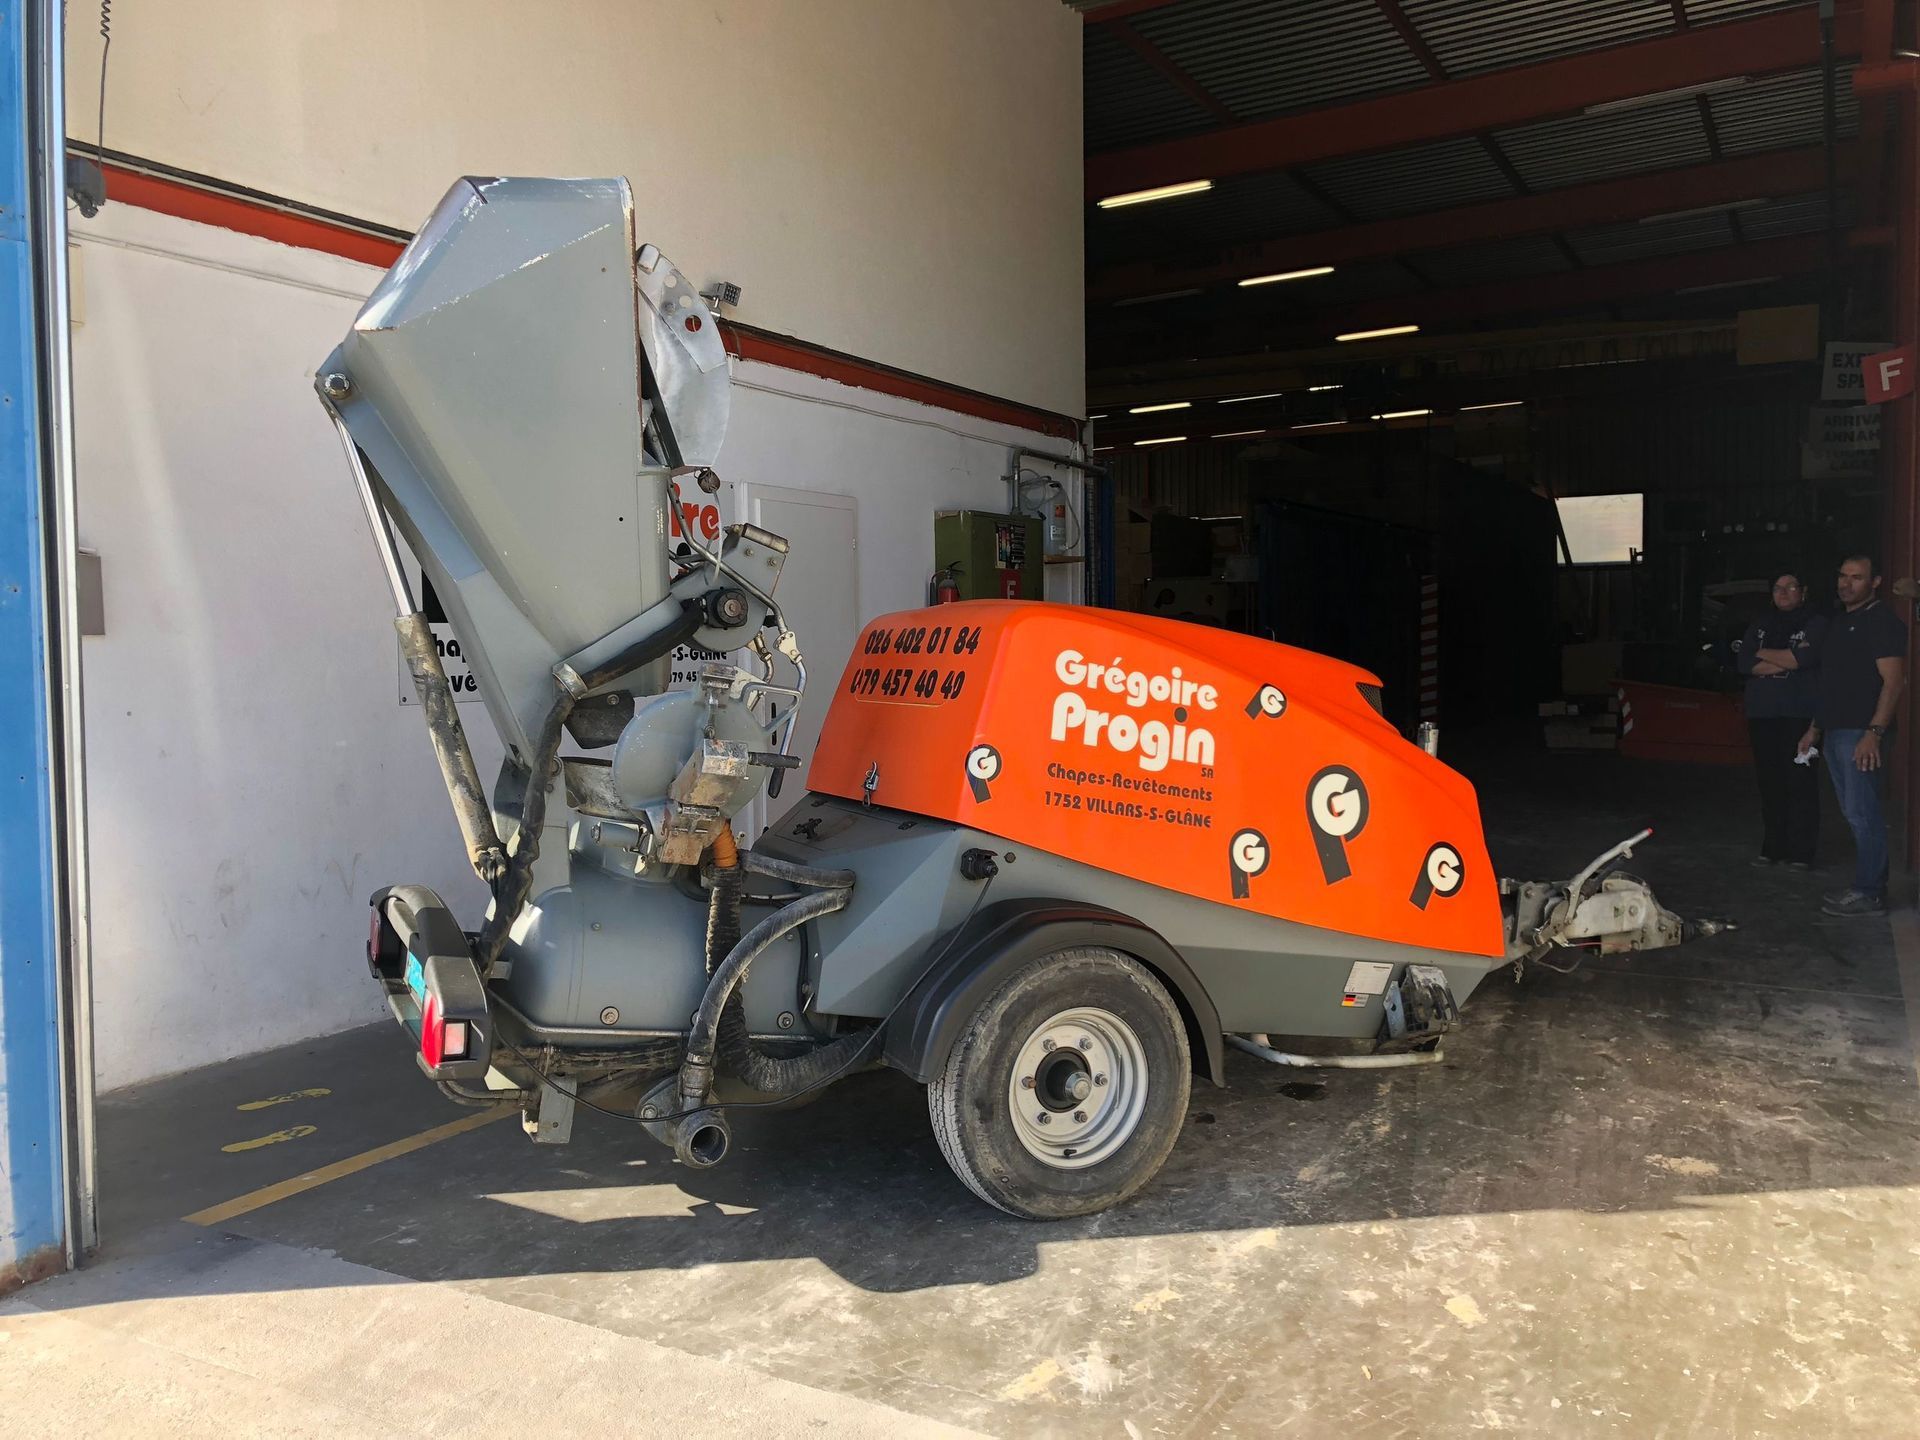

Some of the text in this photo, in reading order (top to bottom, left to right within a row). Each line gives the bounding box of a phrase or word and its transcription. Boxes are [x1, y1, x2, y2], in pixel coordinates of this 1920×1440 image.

[1880, 358, 1904, 391] F
[864, 625, 982, 655] 026 402 01 84
[881, 668, 914, 697] 457
[914, 669, 939, 699] 40
[1055, 649, 1219, 711] Grégoire
[1050, 692, 1216, 772] Progin
[1047, 762, 1214, 802] Chapes-Revêtements
[1201, 767, 1214, 779] SA
[1044, 791, 1212, 829] 1752 VILLARS-S-GLÂNE
